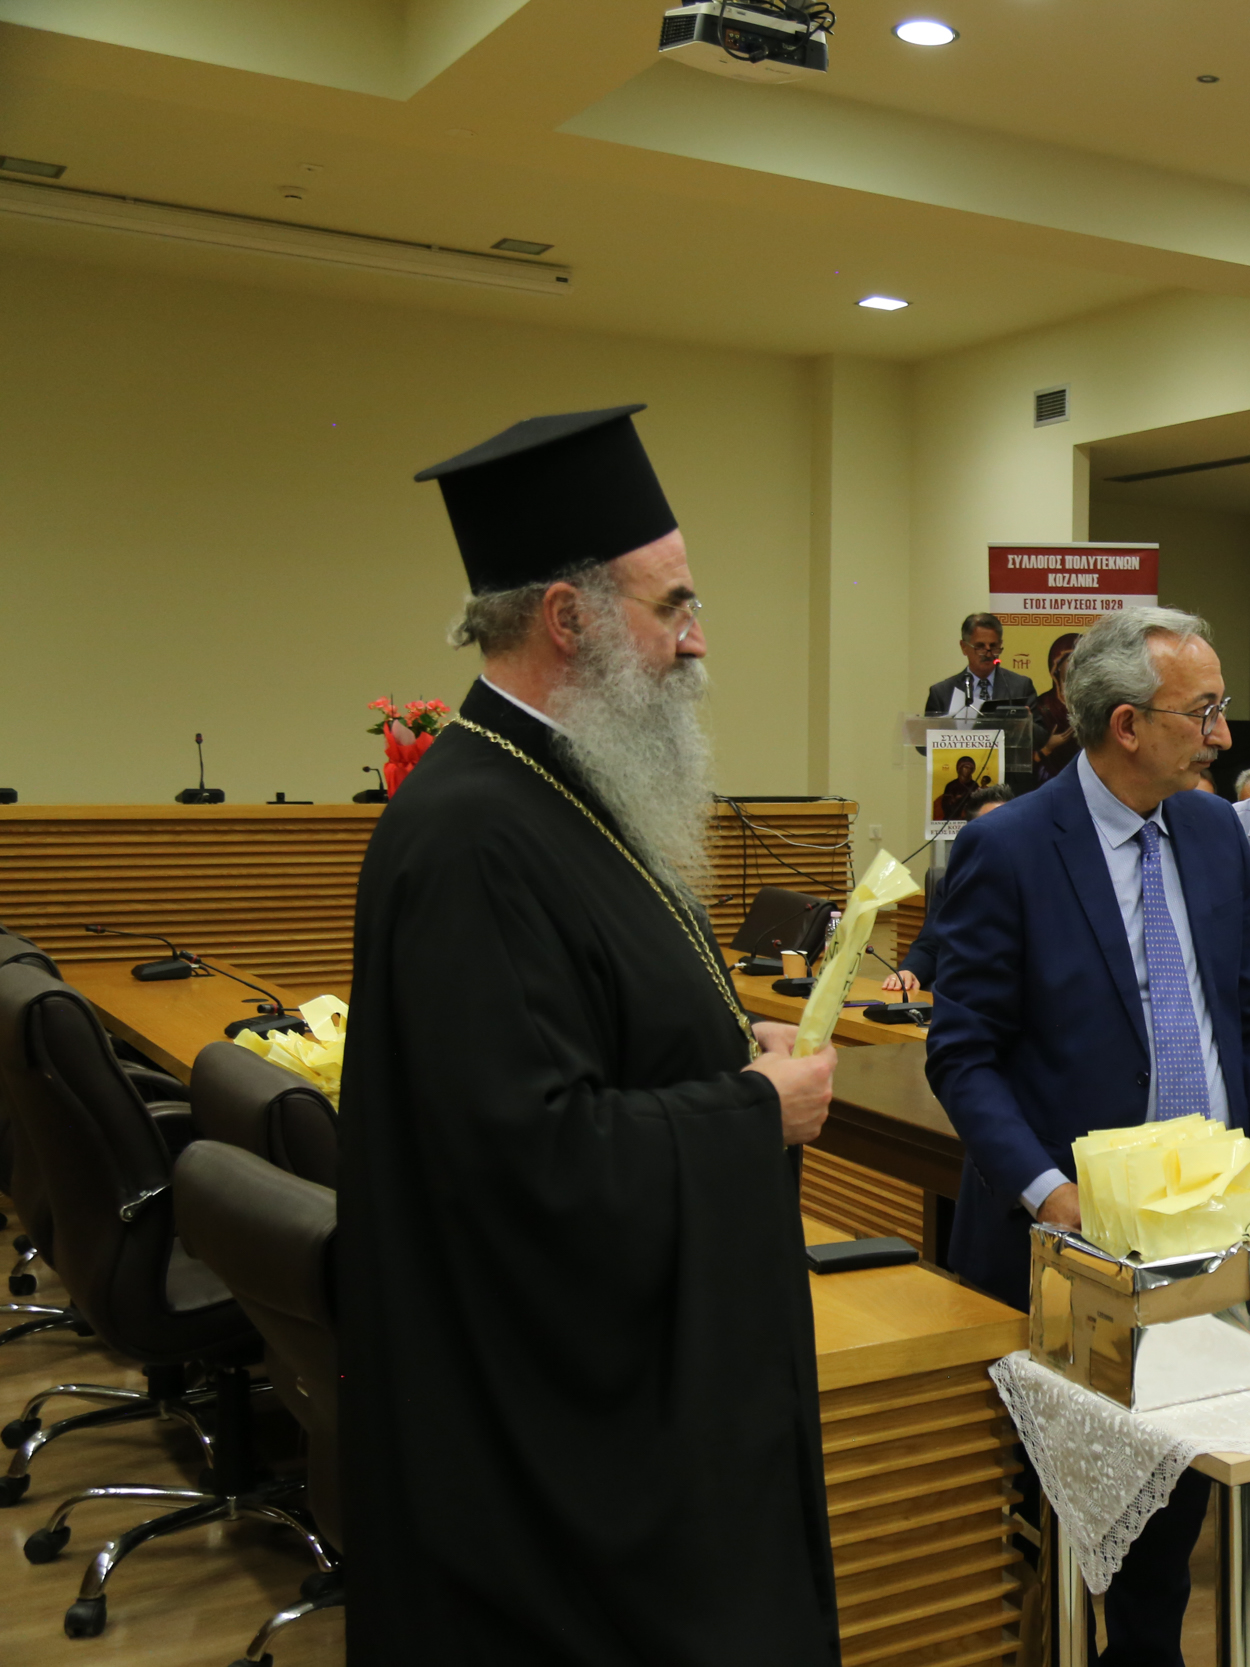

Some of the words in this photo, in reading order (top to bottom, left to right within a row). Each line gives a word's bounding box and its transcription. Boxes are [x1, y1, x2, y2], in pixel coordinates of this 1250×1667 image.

[1007, 555, 1062, 569] ΣΥΛΛΟΓΟΣ
[1065, 555, 1140, 570] ΠΟΛΥΤΕΚΝΩΝ
[1048, 573, 1099, 588] ΚΟΖΑΝΗΣ
[1023, 598, 1047, 610] ΕΤΟΣ
[1050, 599, 1097, 610] ΙΔΡΥΣΕΩΣ
[941, 734, 991, 742] ΣΥΛΛΟΓΟΣ
